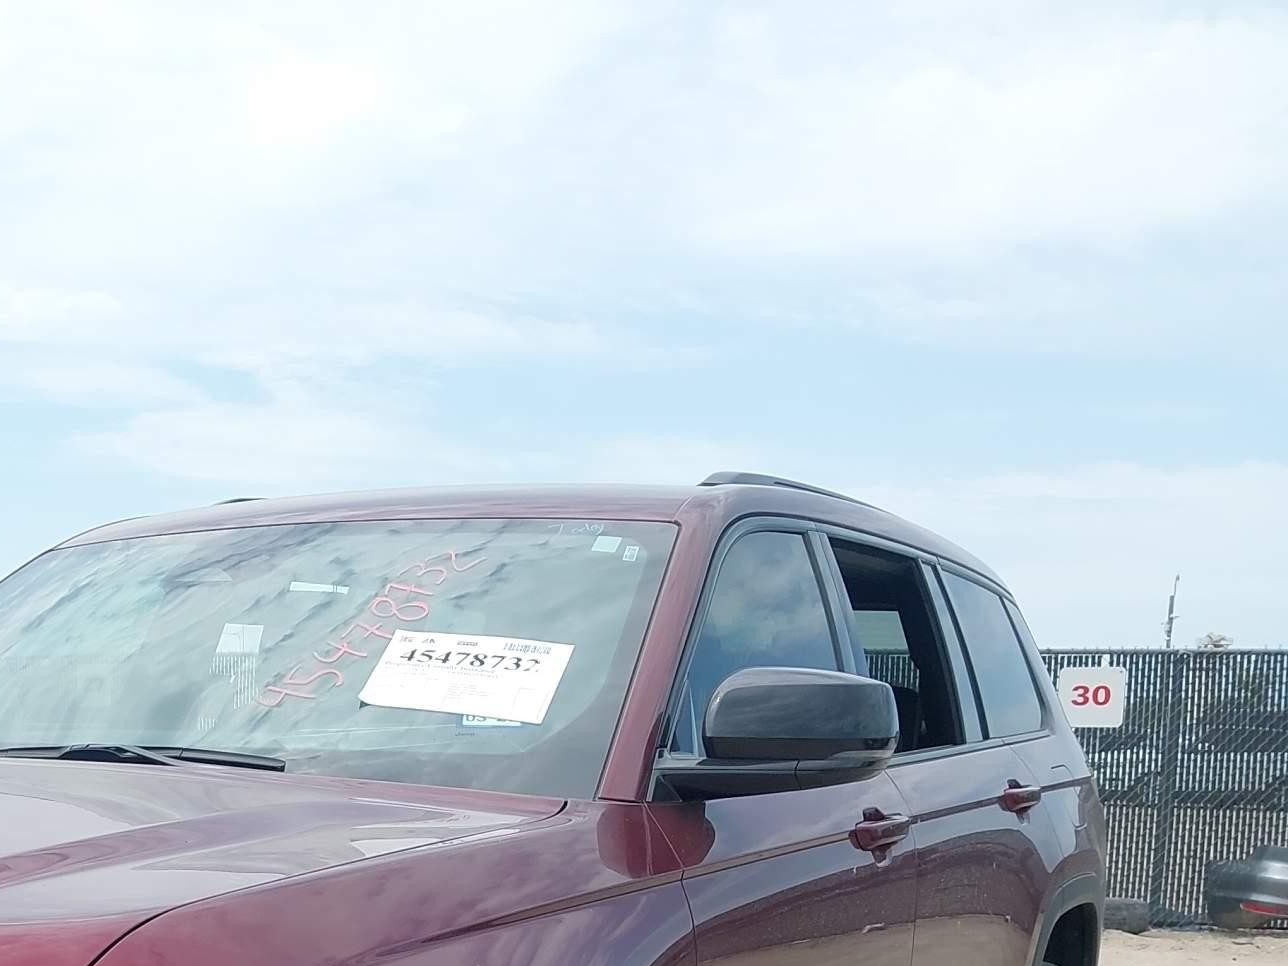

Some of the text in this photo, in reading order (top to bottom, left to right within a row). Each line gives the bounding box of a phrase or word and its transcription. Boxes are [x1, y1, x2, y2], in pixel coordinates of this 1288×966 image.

[257, 551, 488, 707] 45478732
[400, 648, 541, 673] 45478732
[1071, 685, 1111, 706] 30
